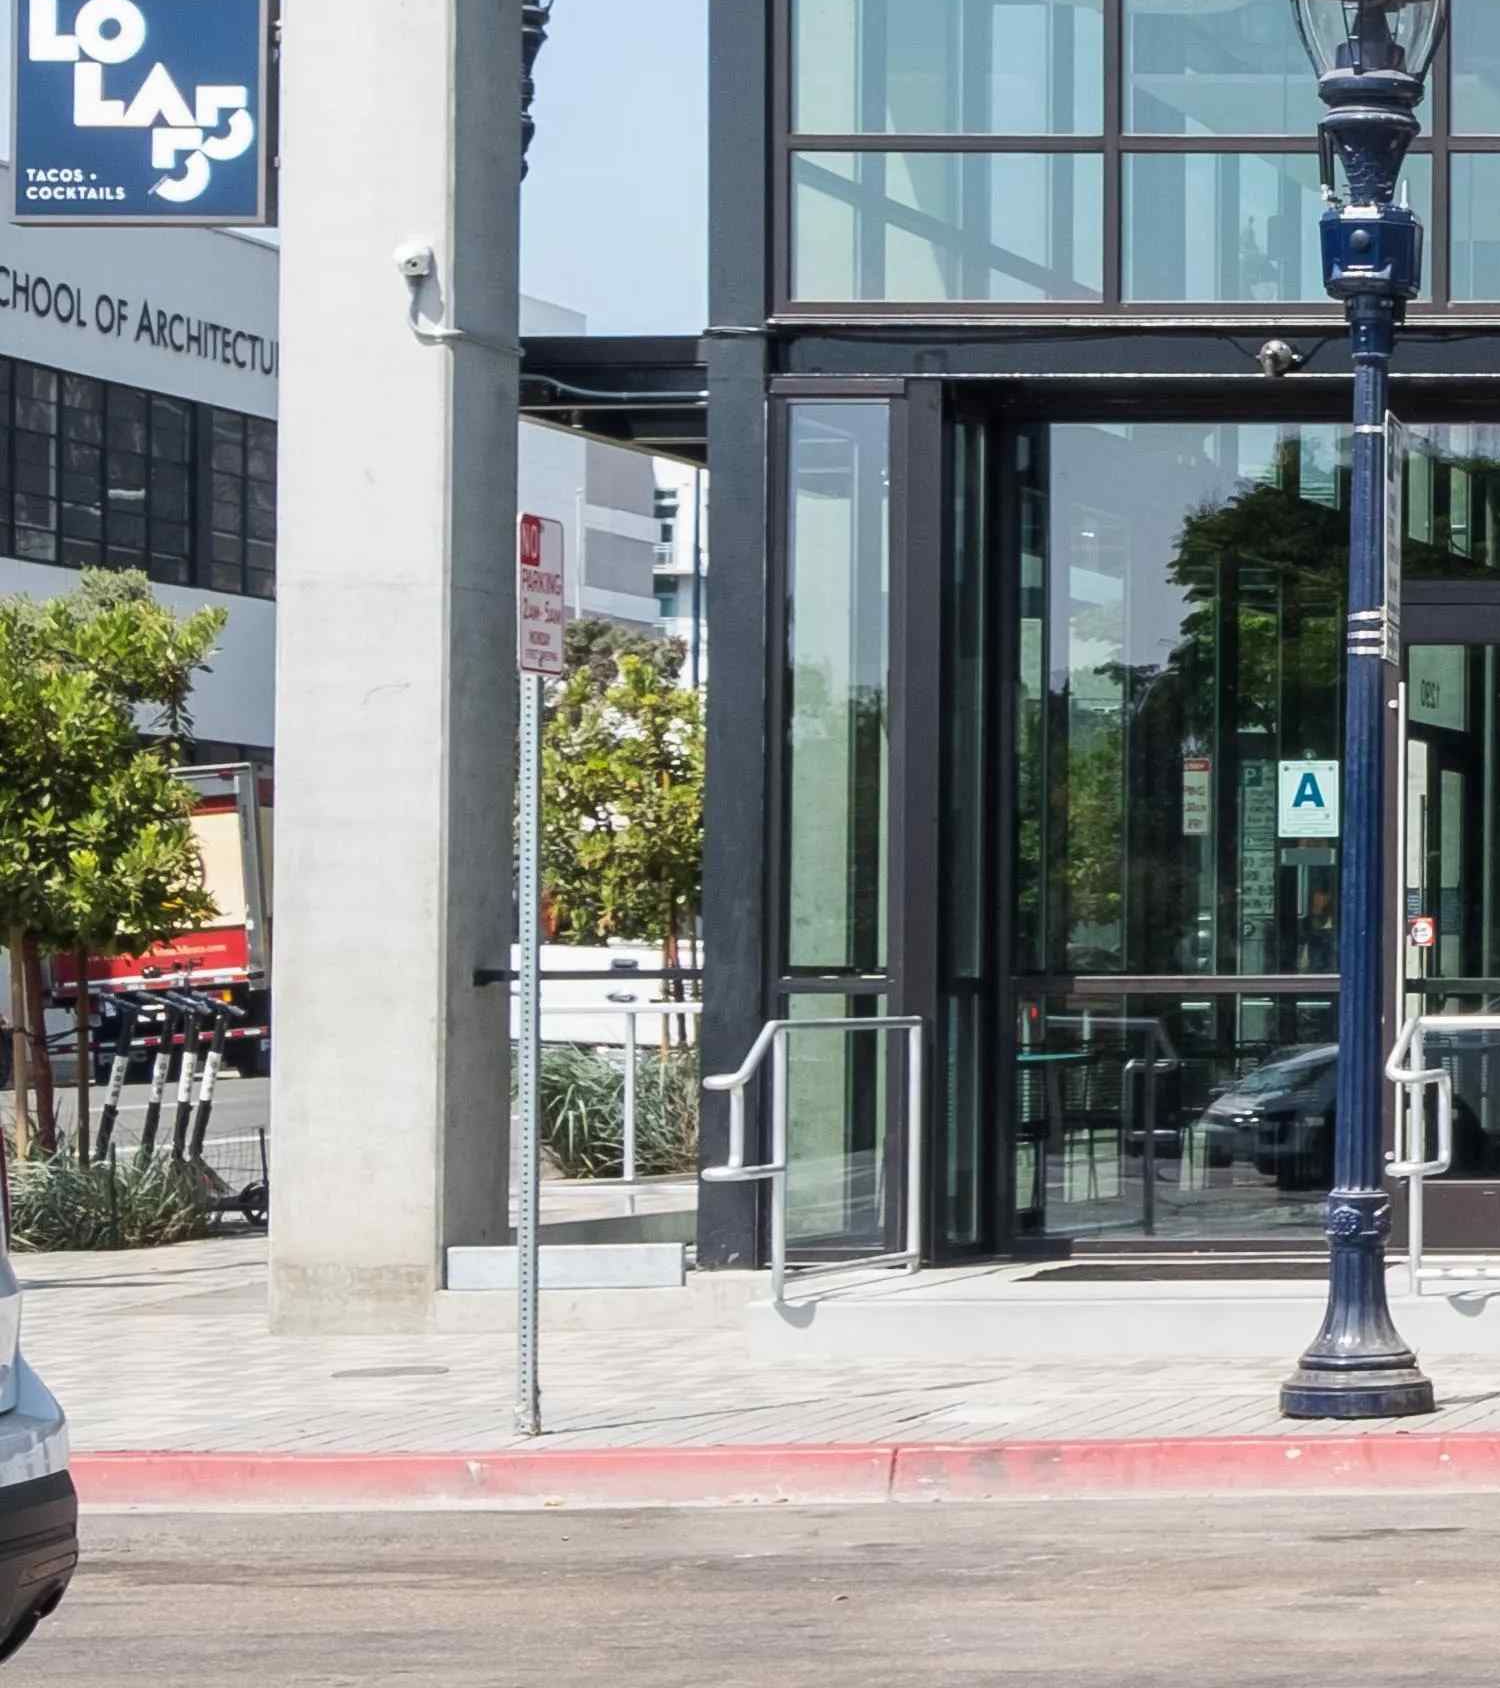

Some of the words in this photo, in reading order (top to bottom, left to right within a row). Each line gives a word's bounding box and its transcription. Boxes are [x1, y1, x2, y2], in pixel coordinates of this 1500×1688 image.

[26, 168, 83, 182] TACOS
[26, 186, 126, 200] COCKTAILS
[95, 294, 128, 336] OF
[134, 300, 279, 378] ARCHITECTU
[1292, 773, 1325, 807] A
